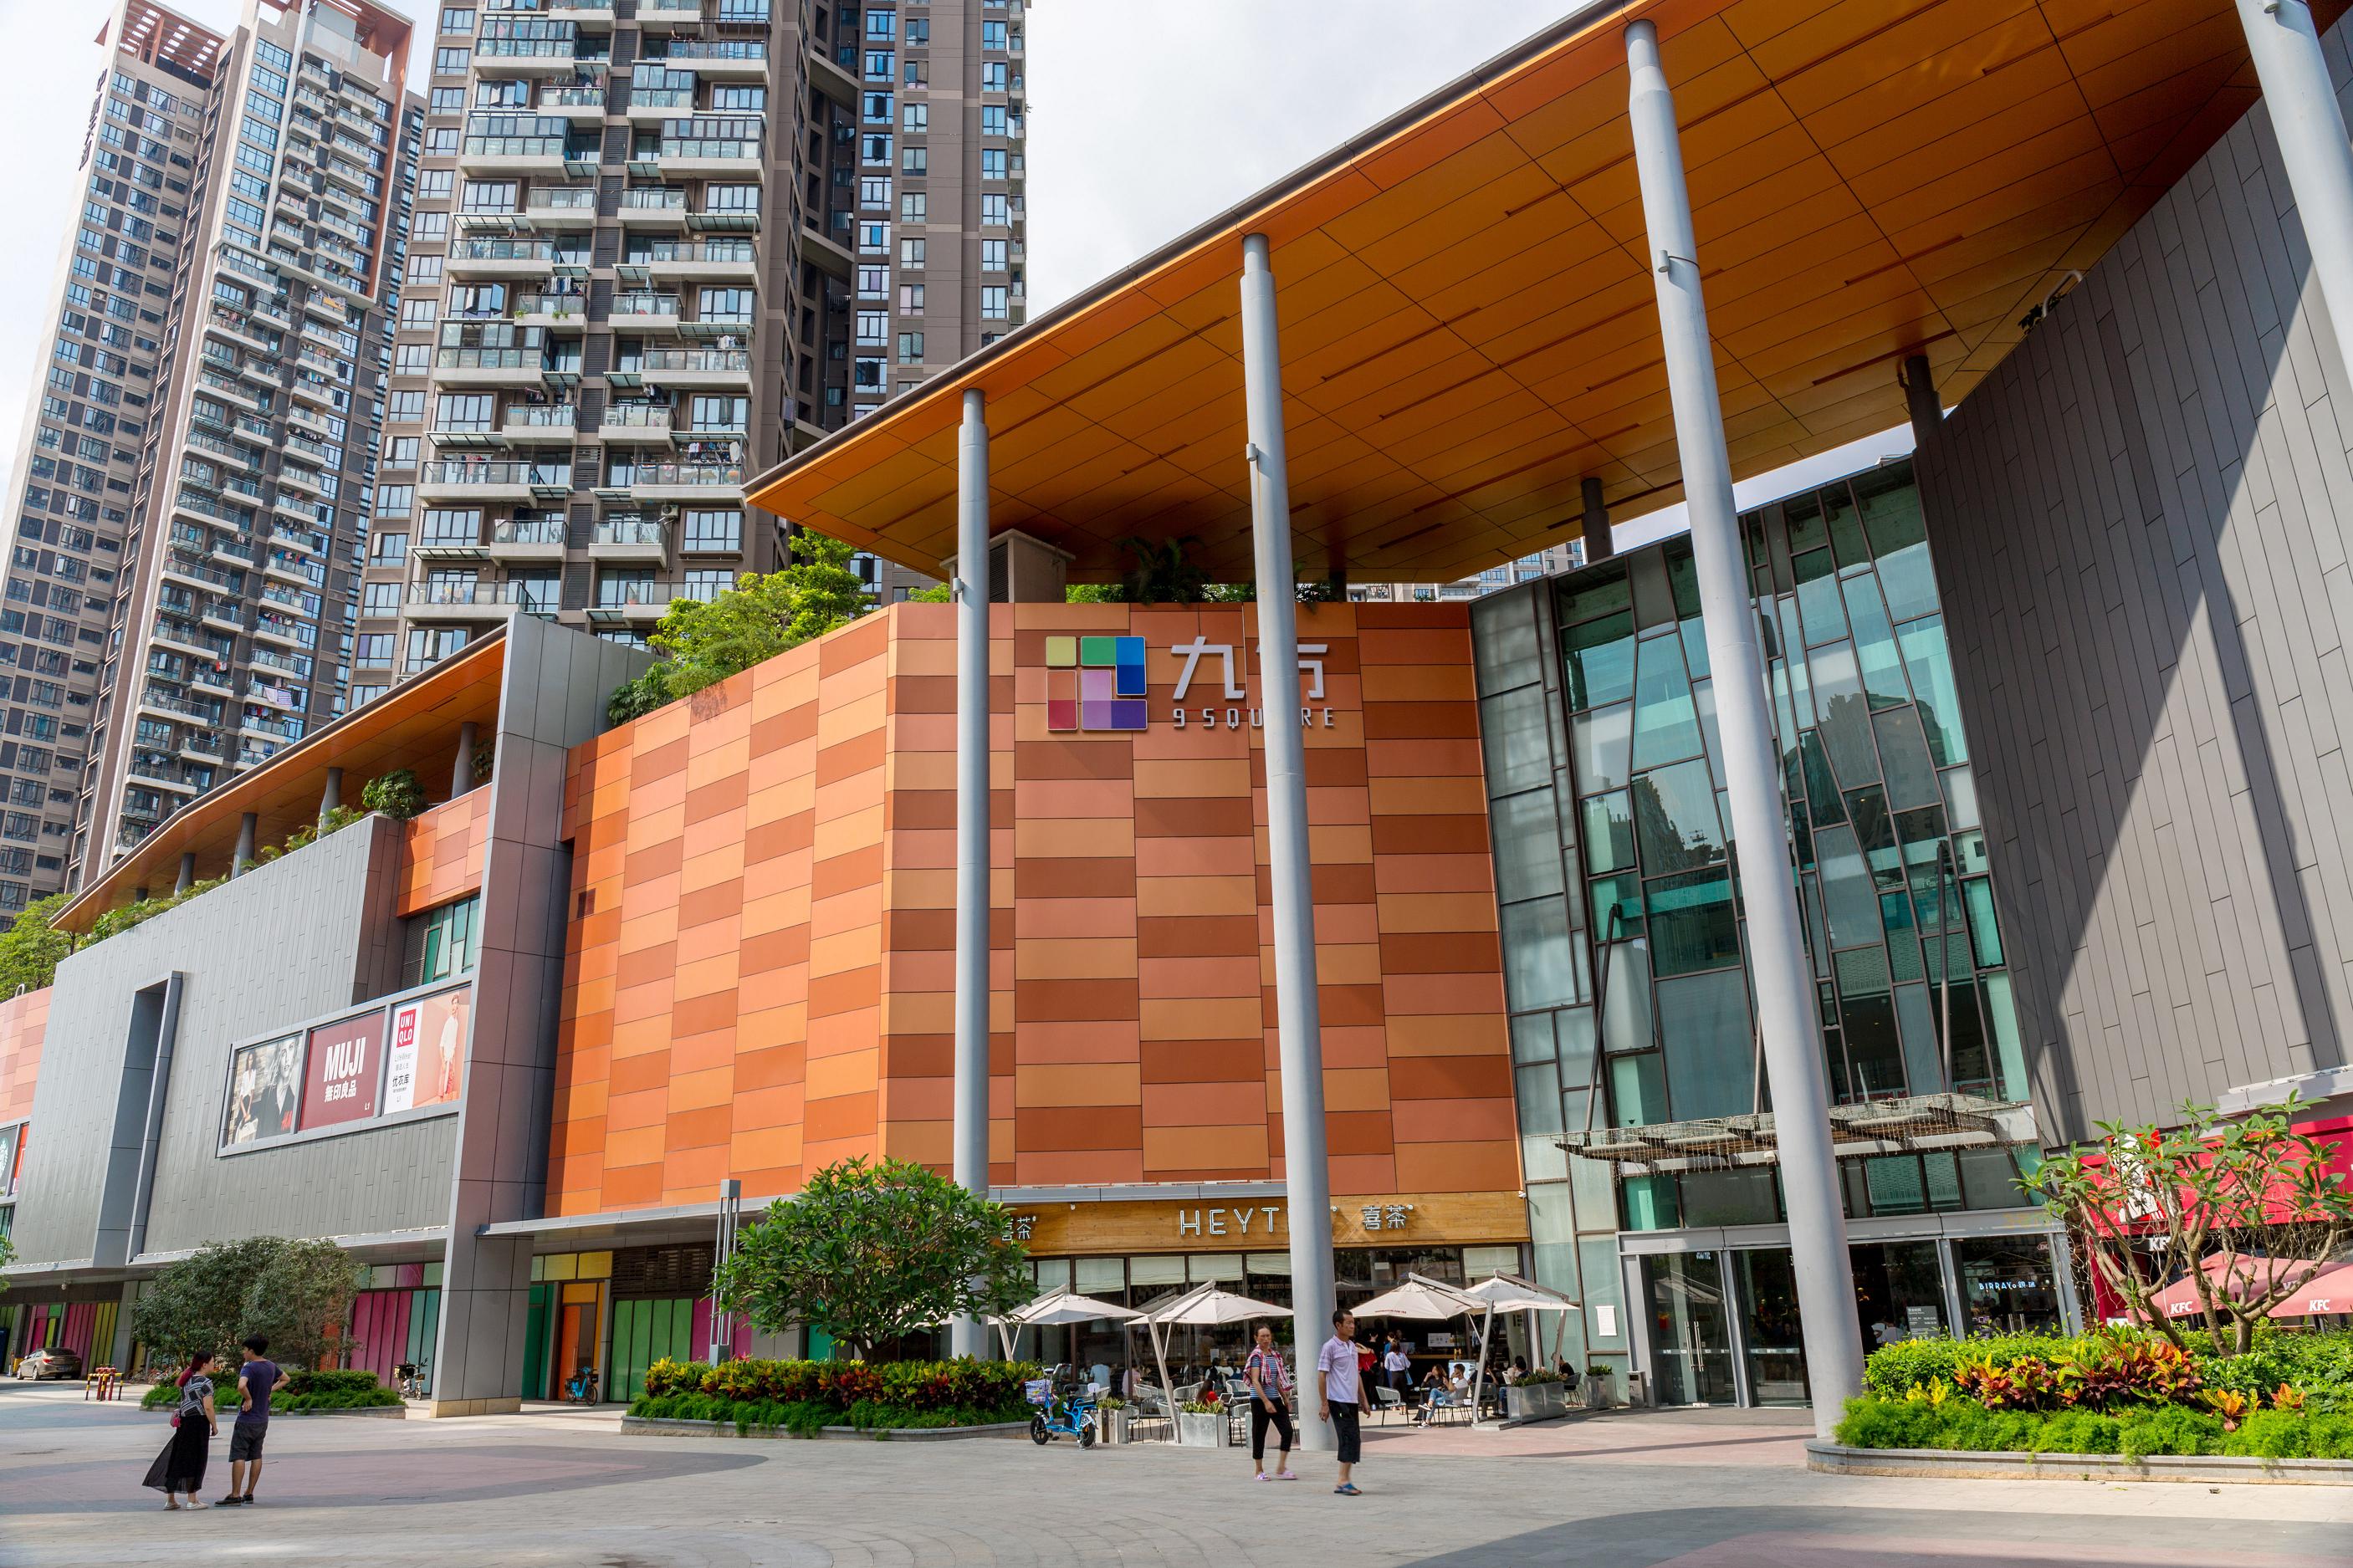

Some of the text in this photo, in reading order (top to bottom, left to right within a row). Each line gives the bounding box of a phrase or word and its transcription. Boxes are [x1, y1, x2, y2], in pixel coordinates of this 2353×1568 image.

[1203, 707, 1335, 729] SQURE
[400, 1014, 414, 1028] UNI
[398, 1029, 412, 1044] QLO
[323, 1037, 366, 1082] MUJI
[324, 1080, 357, 1102] 無印良品
[364, 1102, 371, 1111] L1
[1179, 1206, 1289, 1237] HEYT
[1361, 1204, 1408, 1231] 喜茶
[2170, 1300, 2193, 1315] KFC
[2308, 1299, 2330, 1312] KFC
